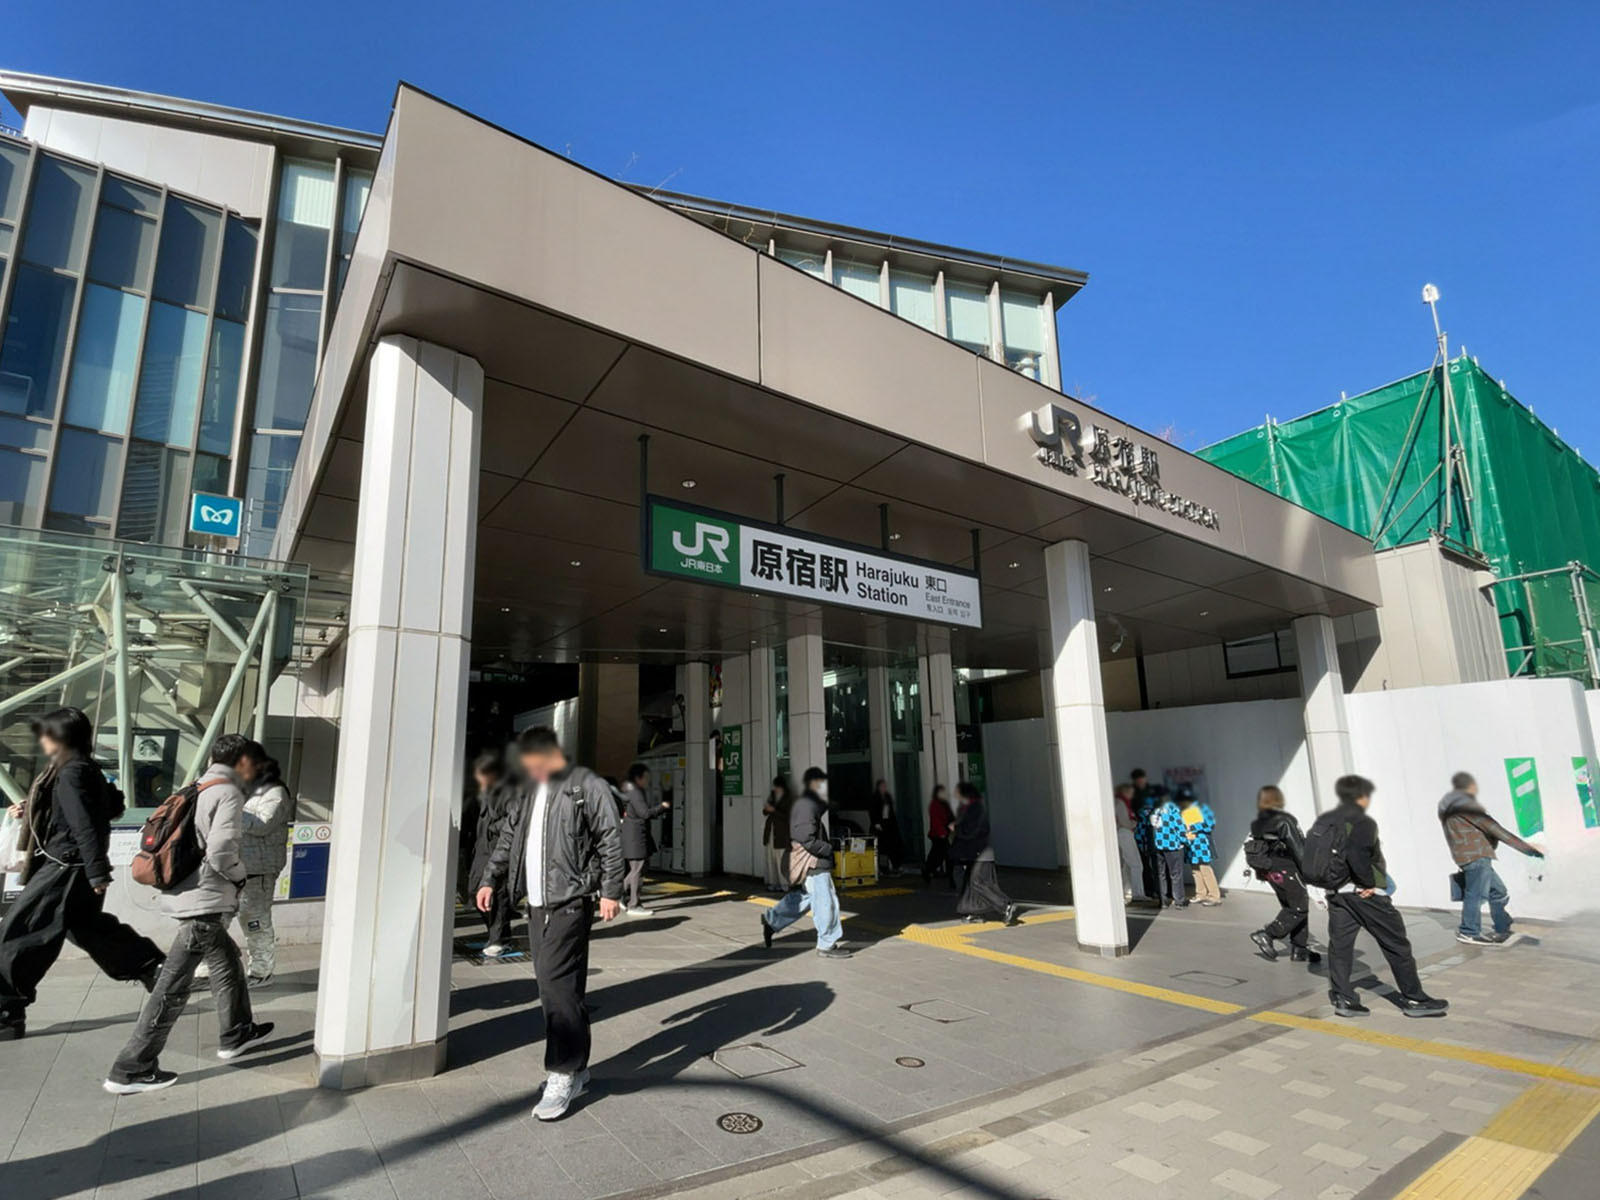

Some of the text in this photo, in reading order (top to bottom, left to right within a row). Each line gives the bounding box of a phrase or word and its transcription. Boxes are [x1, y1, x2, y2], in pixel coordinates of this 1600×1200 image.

[1020, 402, 1086, 468] JR
[672, 521, 730, 564] JR
[750, 539, 850, 595] 原宿駅
[855, 561, 919, 589] Harajuku
[857, 582, 909, 606] Station
[925, 575, 947, 593] 東口
[725, 751, 740, 767] JR
